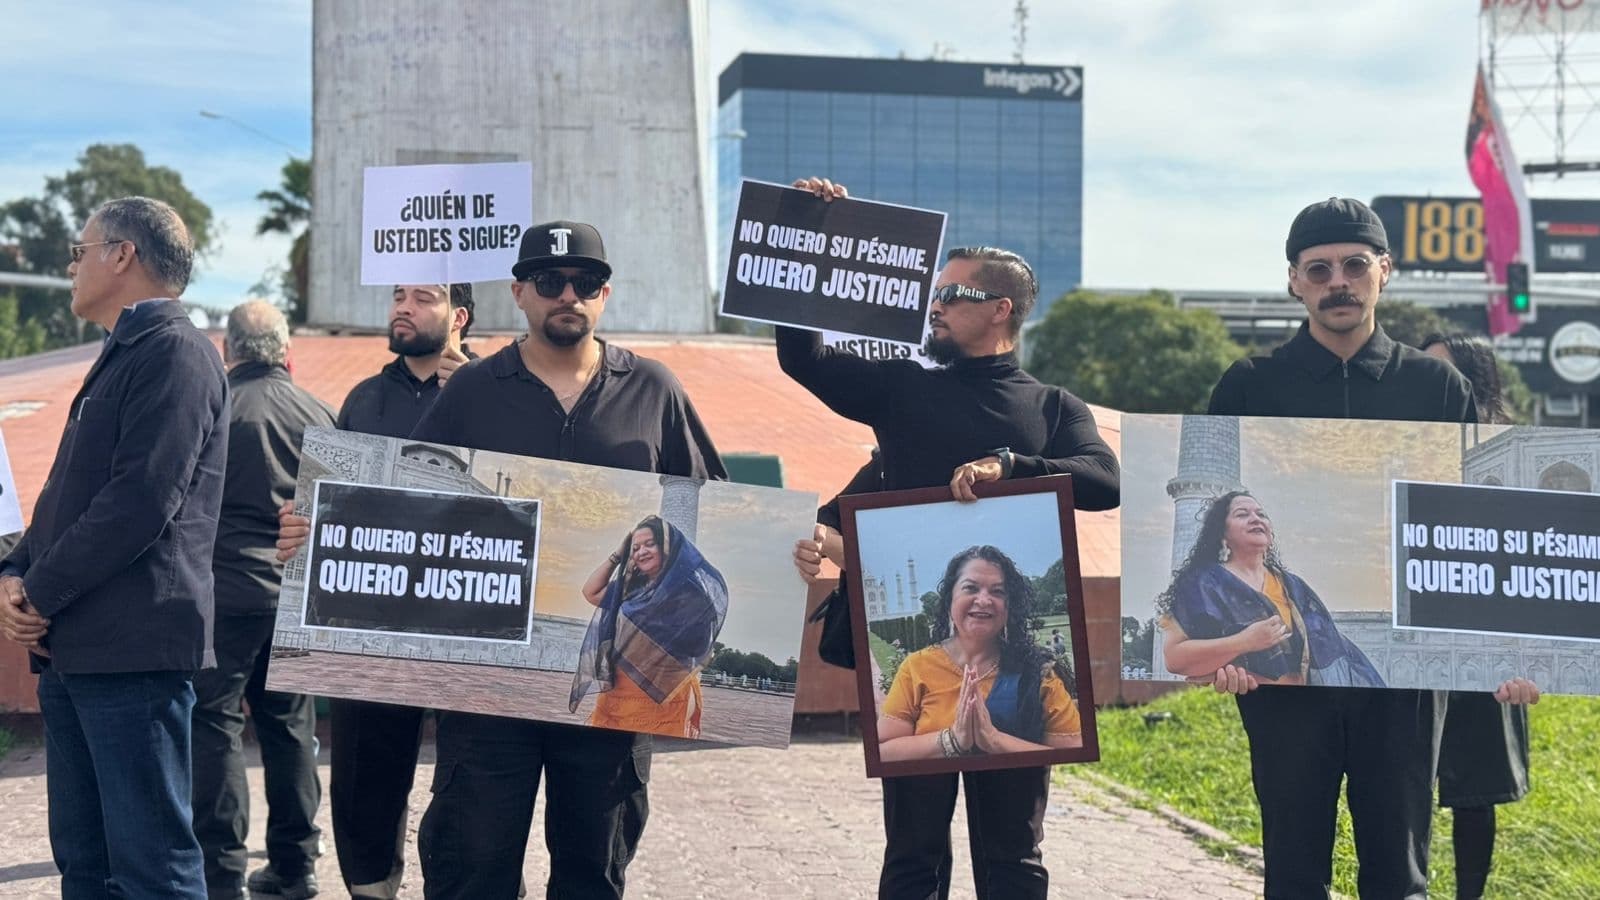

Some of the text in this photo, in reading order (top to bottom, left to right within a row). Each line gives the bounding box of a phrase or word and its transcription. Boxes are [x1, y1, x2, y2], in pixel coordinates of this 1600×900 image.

[400, 189, 495, 222] ¿QUIÉN DE
[374, 224, 521, 253] USTEDES SIGUE?
[739, 219, 929, 275] NO QUIERO SU PÉSAME,
[736, 253, 921, 310] QUIERO JUSTICIA
[956, 284, 986, 300] Palm
[320, 524, 528, 566] NO QUIERO SU PÉSAME,
[1402, 523, 1600, 560] NO QUIERO SU PÉSAM
[319, 559, 522, 605] QUIERO JUSTICIA
[1406, 559, 1495, 595] QUIERO
